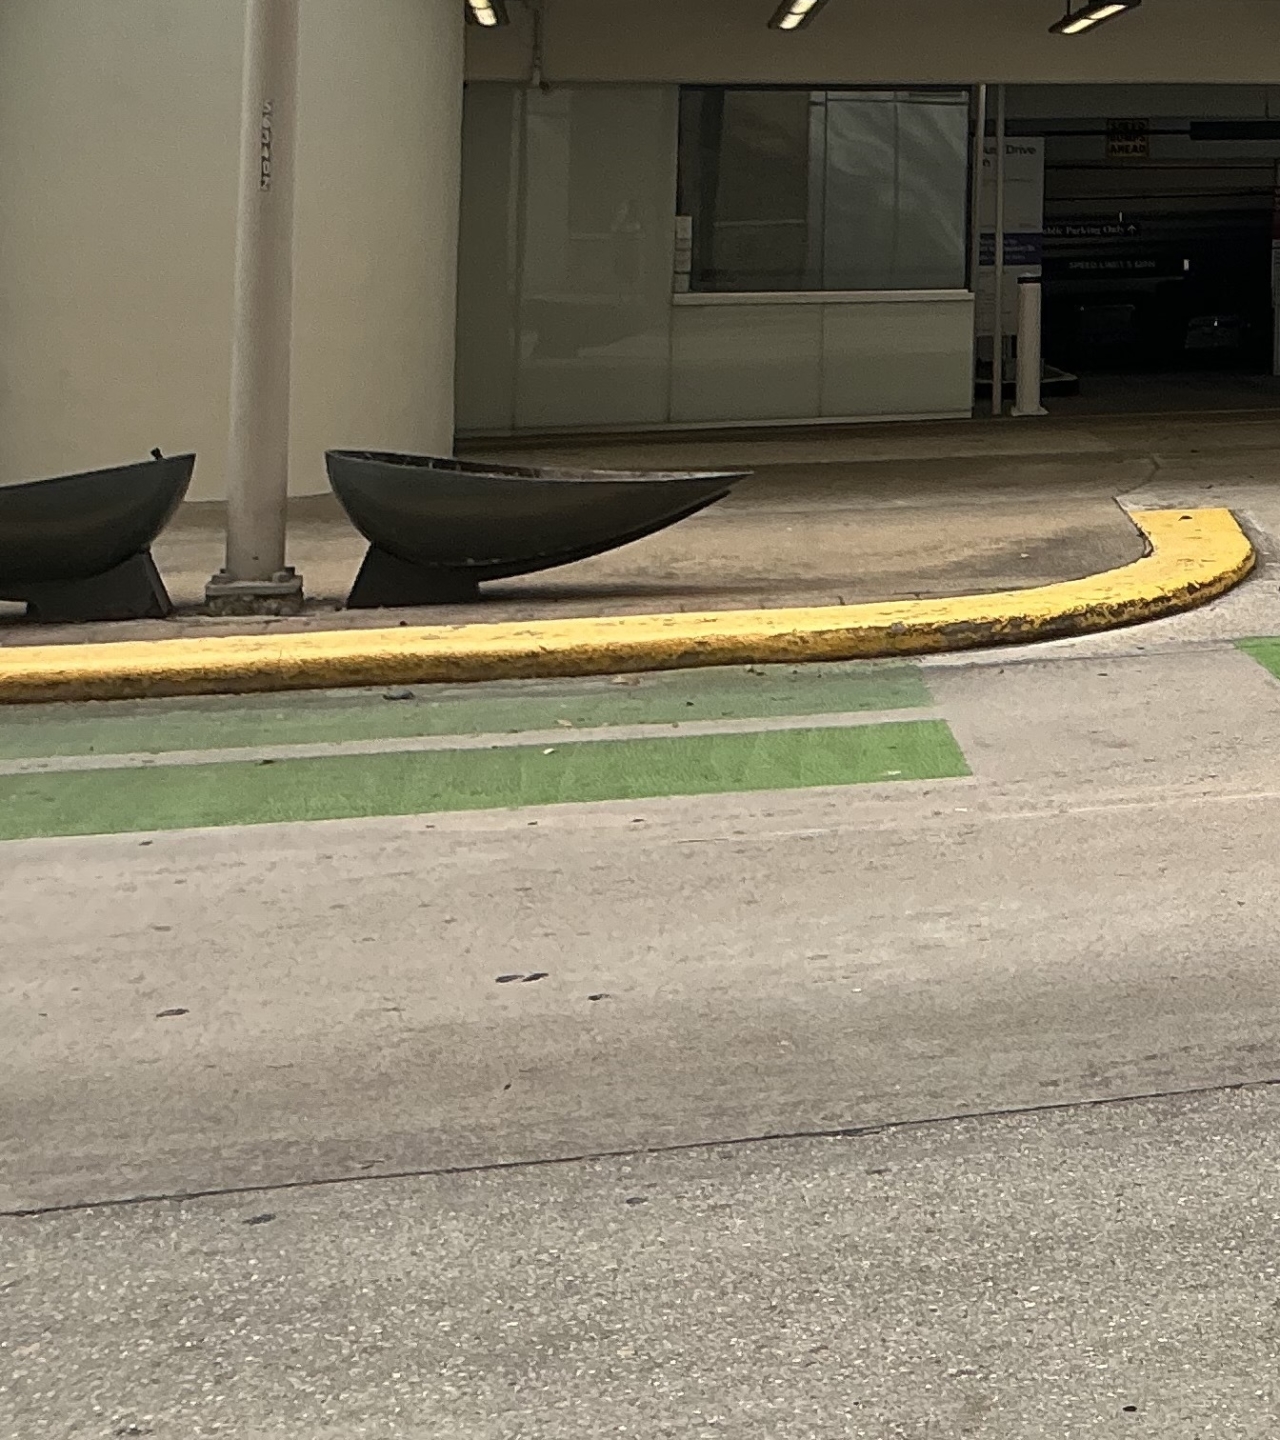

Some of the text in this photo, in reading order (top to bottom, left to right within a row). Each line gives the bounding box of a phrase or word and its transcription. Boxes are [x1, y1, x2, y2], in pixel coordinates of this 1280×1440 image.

[1005, 145, 1036, 155] Drive
[1110, 144, 1146, 154] AHEAD
[1065, 225, 1102, 237] Parking
